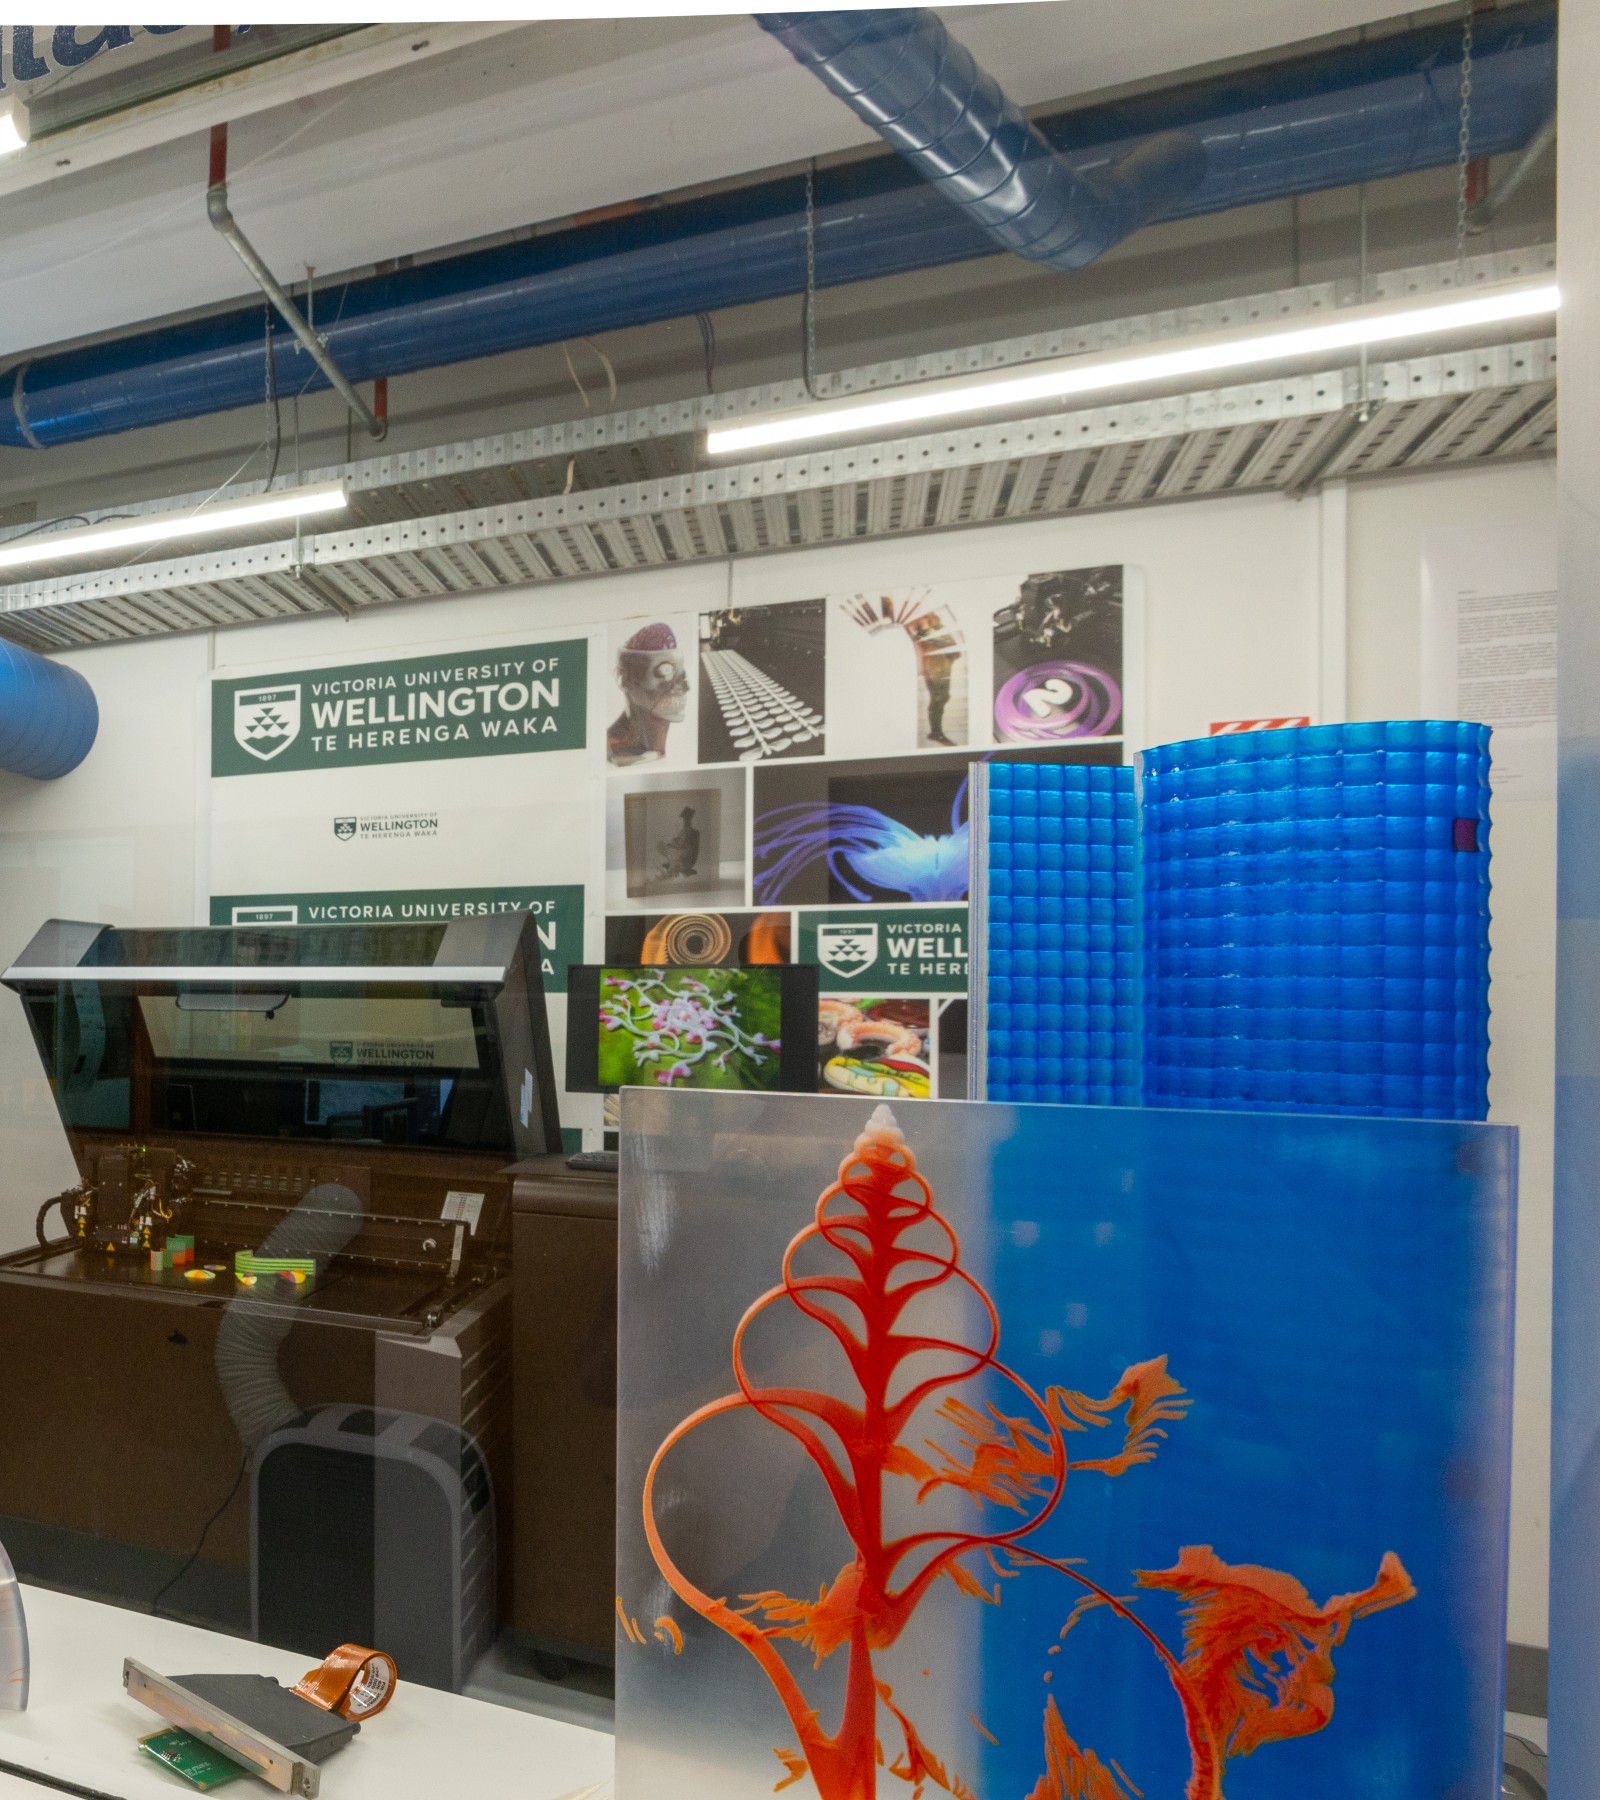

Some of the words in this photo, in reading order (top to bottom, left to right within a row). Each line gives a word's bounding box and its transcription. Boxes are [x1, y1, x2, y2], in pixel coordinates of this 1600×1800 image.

[312, 676, 396, 697] VICTORIA
[404, 661, 525, 686] UNIVERSITY
[532, 658, 559, 673] OF
[258, 694, 277, 702] 1897
[311, 678, 559, 729] WELLINGTON
[312, 735, 337, 752] TE
[349, 724, 469, 749] HERENGA
[481, 716, 558, 738] WAKA
[390, 812, 428, 820] UNIVERSITY
[360, 818, 438, 832] WELLINGTON
[309, 905, 394, 919] VICTORIA
[401, 901, 521, 918] UNIVERSITY
[529, 901, 555, 914] OF
[255, 913, 274, 921] 1897
[887, 923, 962, 934] VICTORIA
[887, 963, 910, 975] TE
[357, 1048, 434, 1060] WELLINGTON
